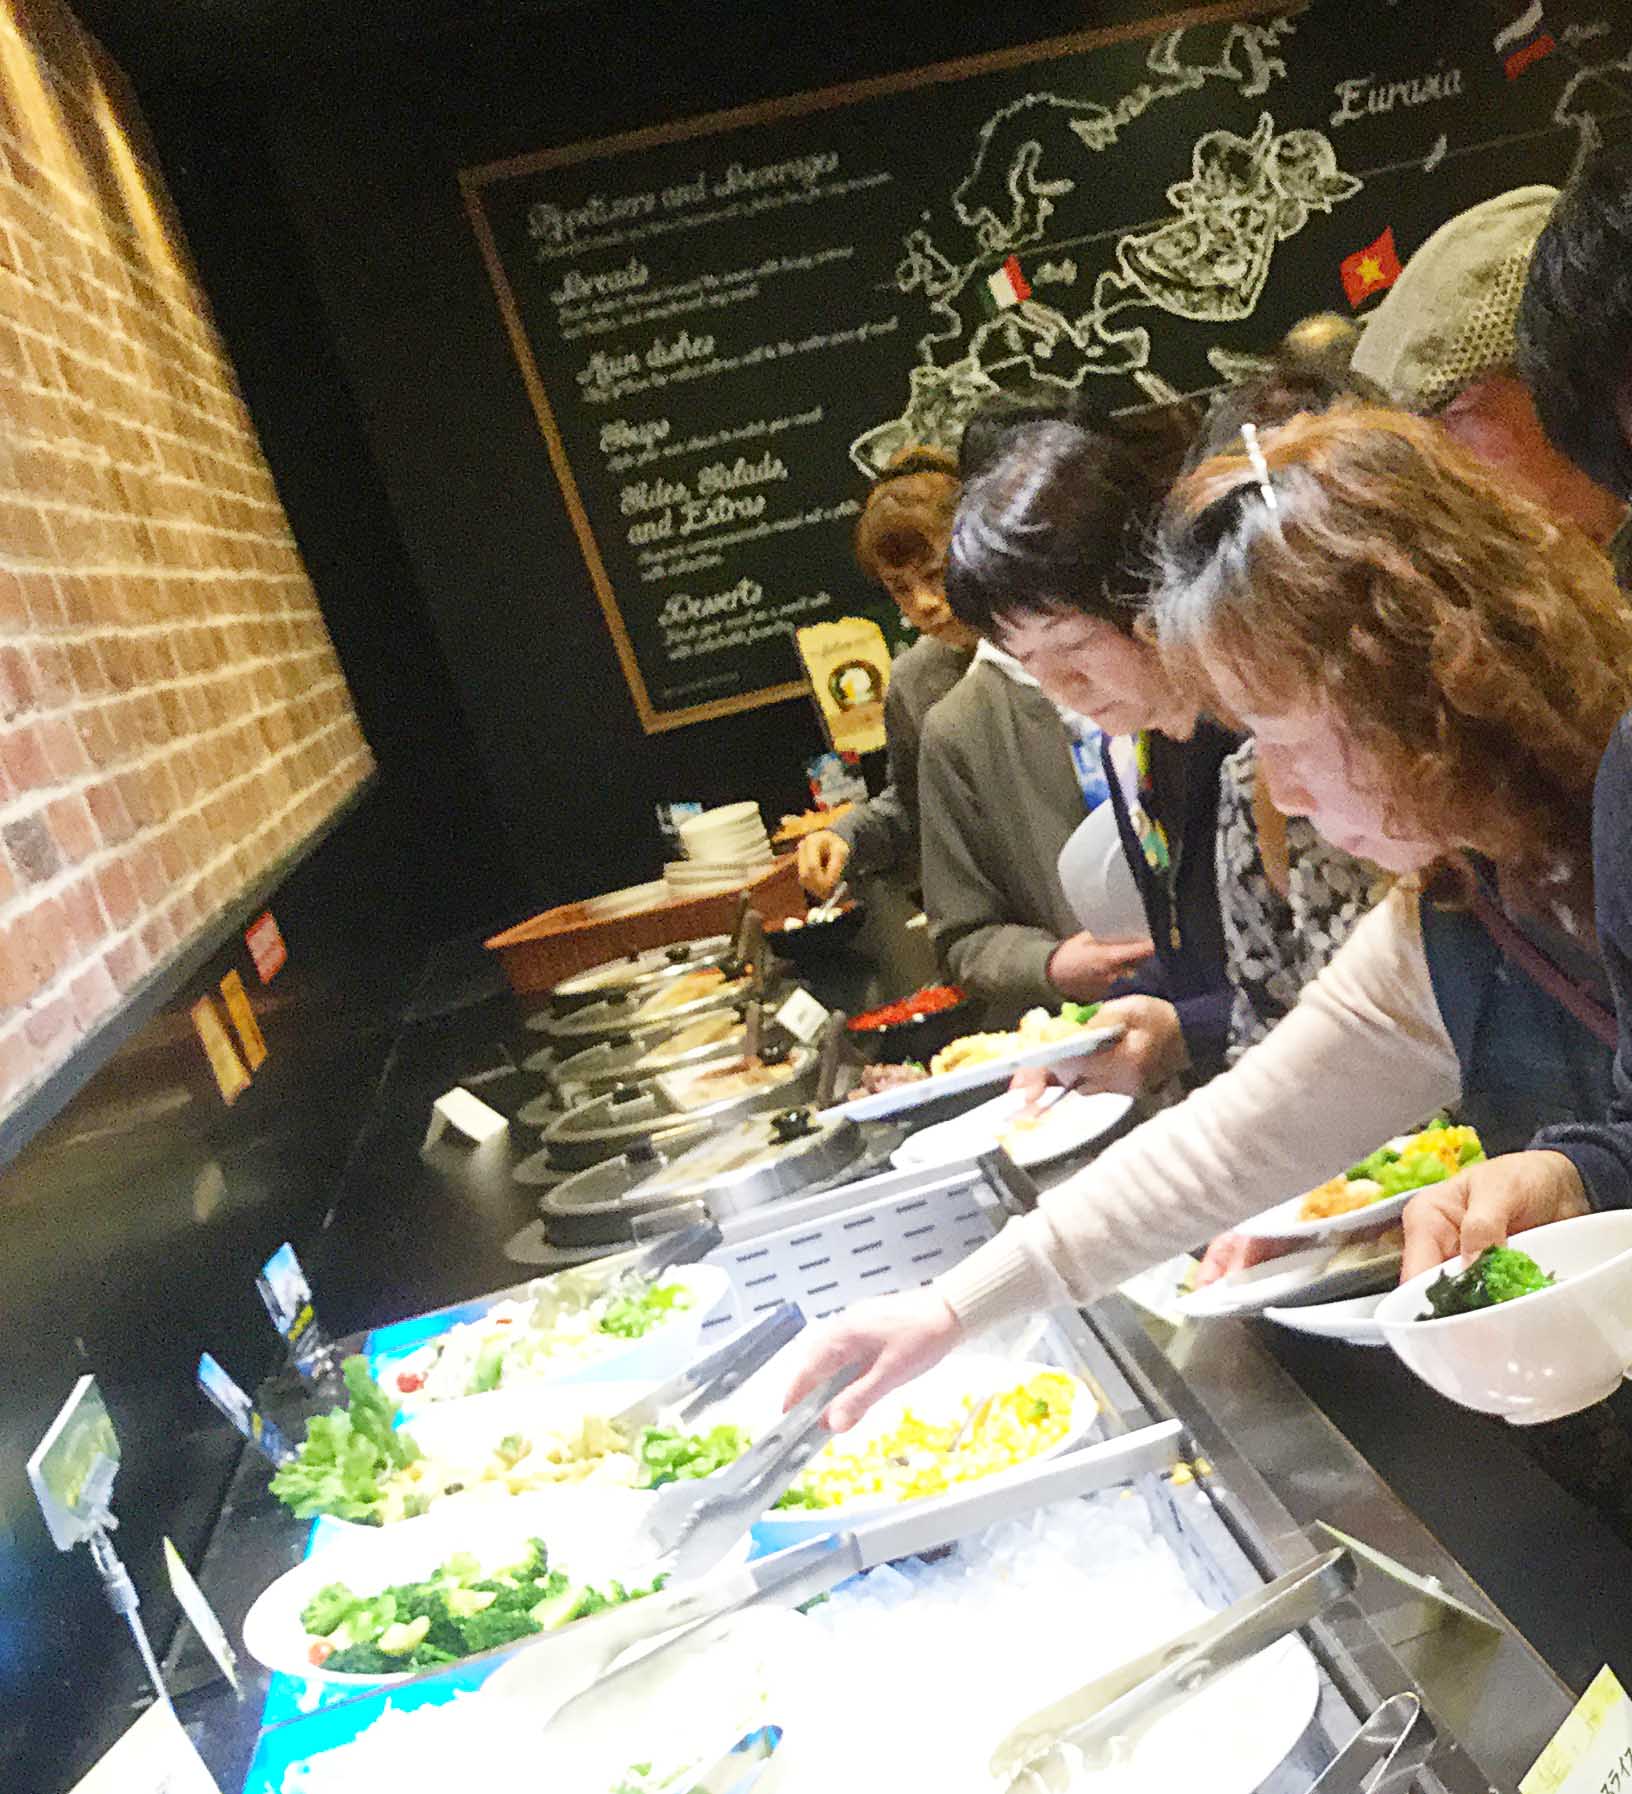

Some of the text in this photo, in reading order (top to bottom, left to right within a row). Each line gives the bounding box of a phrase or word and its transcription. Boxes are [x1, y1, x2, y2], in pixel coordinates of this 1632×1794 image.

[1329, 61, 1462, 127] Eurasia
[627, 507, 673, 545] and
[680, 495, 767, 535] Extras
